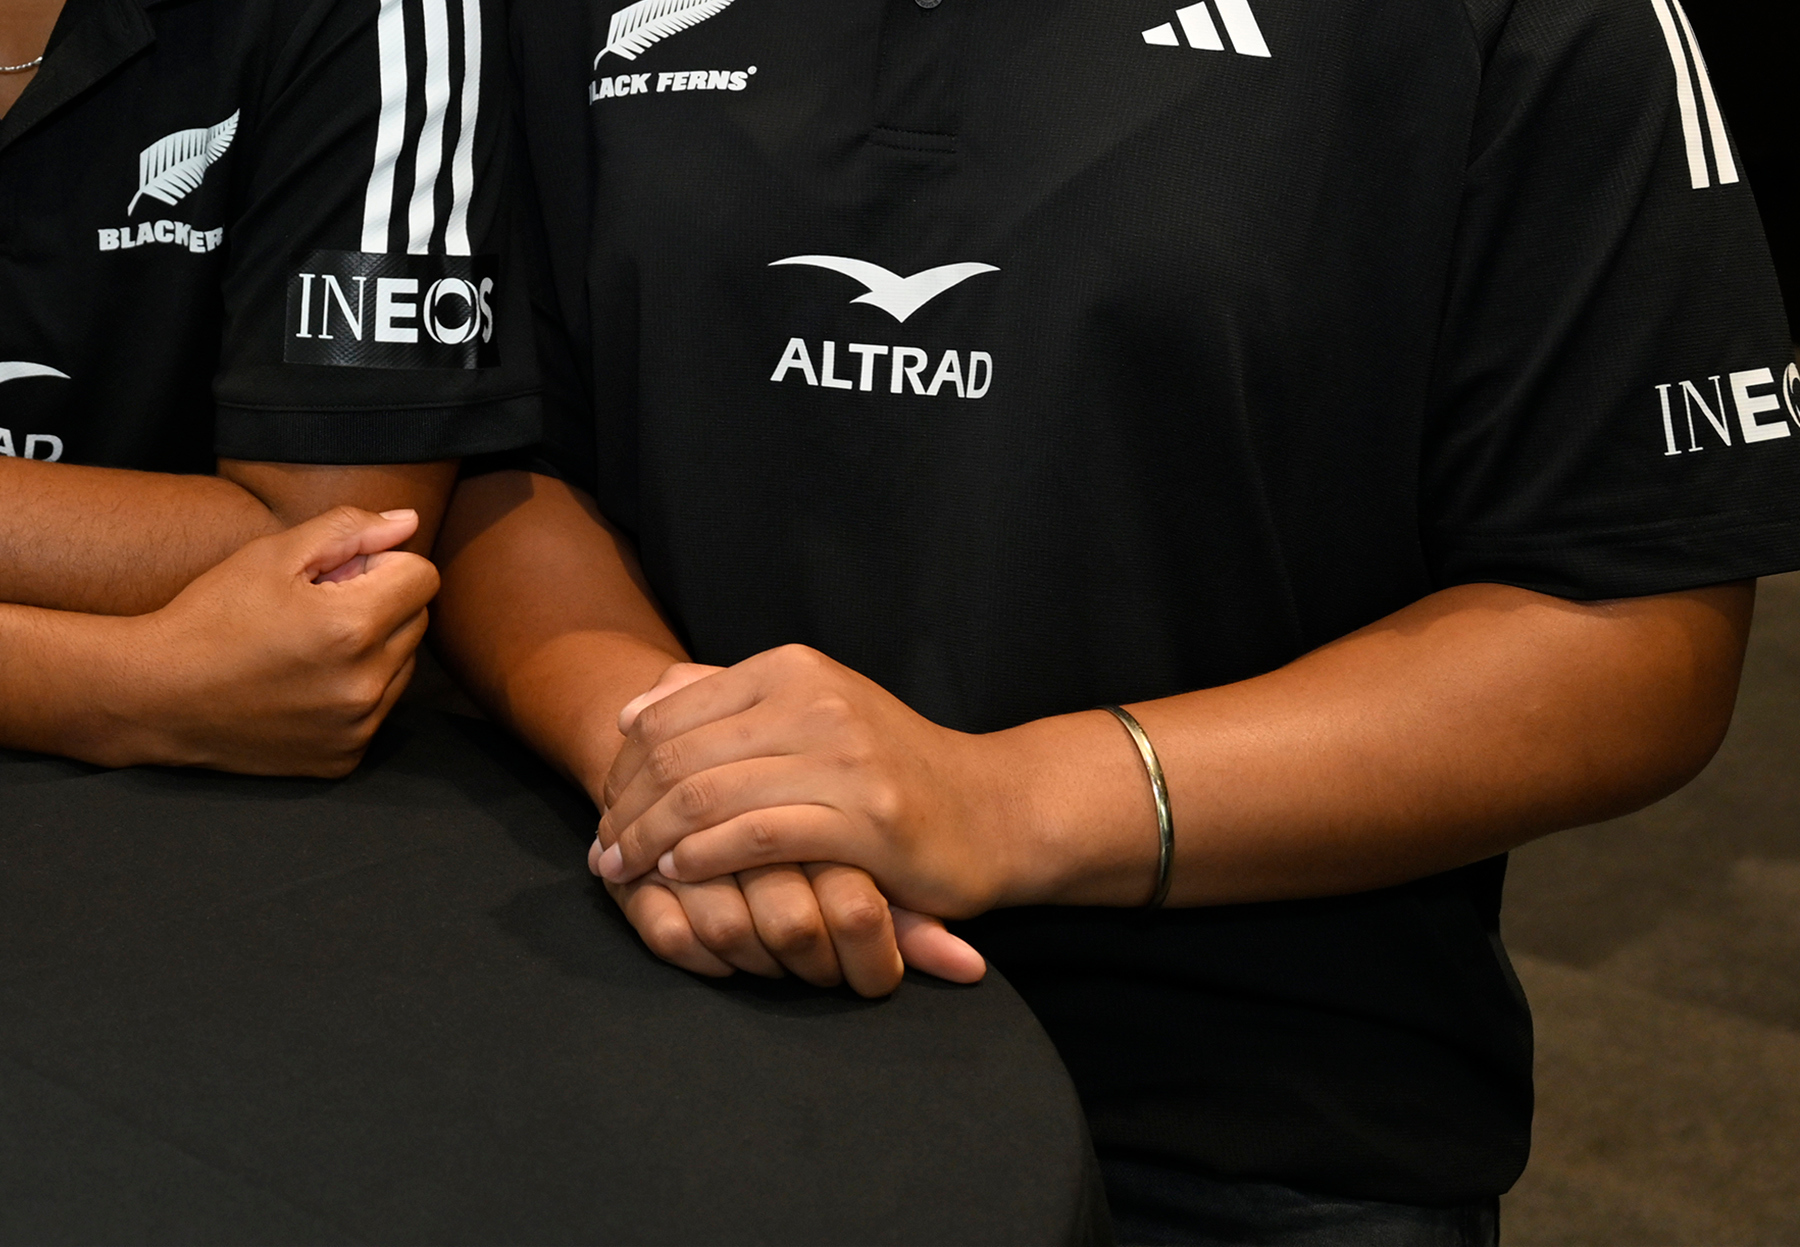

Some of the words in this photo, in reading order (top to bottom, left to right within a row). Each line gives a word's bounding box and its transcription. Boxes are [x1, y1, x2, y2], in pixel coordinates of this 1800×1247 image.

[588, 72, 652, 106] LACK
[295, 272, 494, 345] INEOS
[769, 337, 993, 399] ALTRAD
